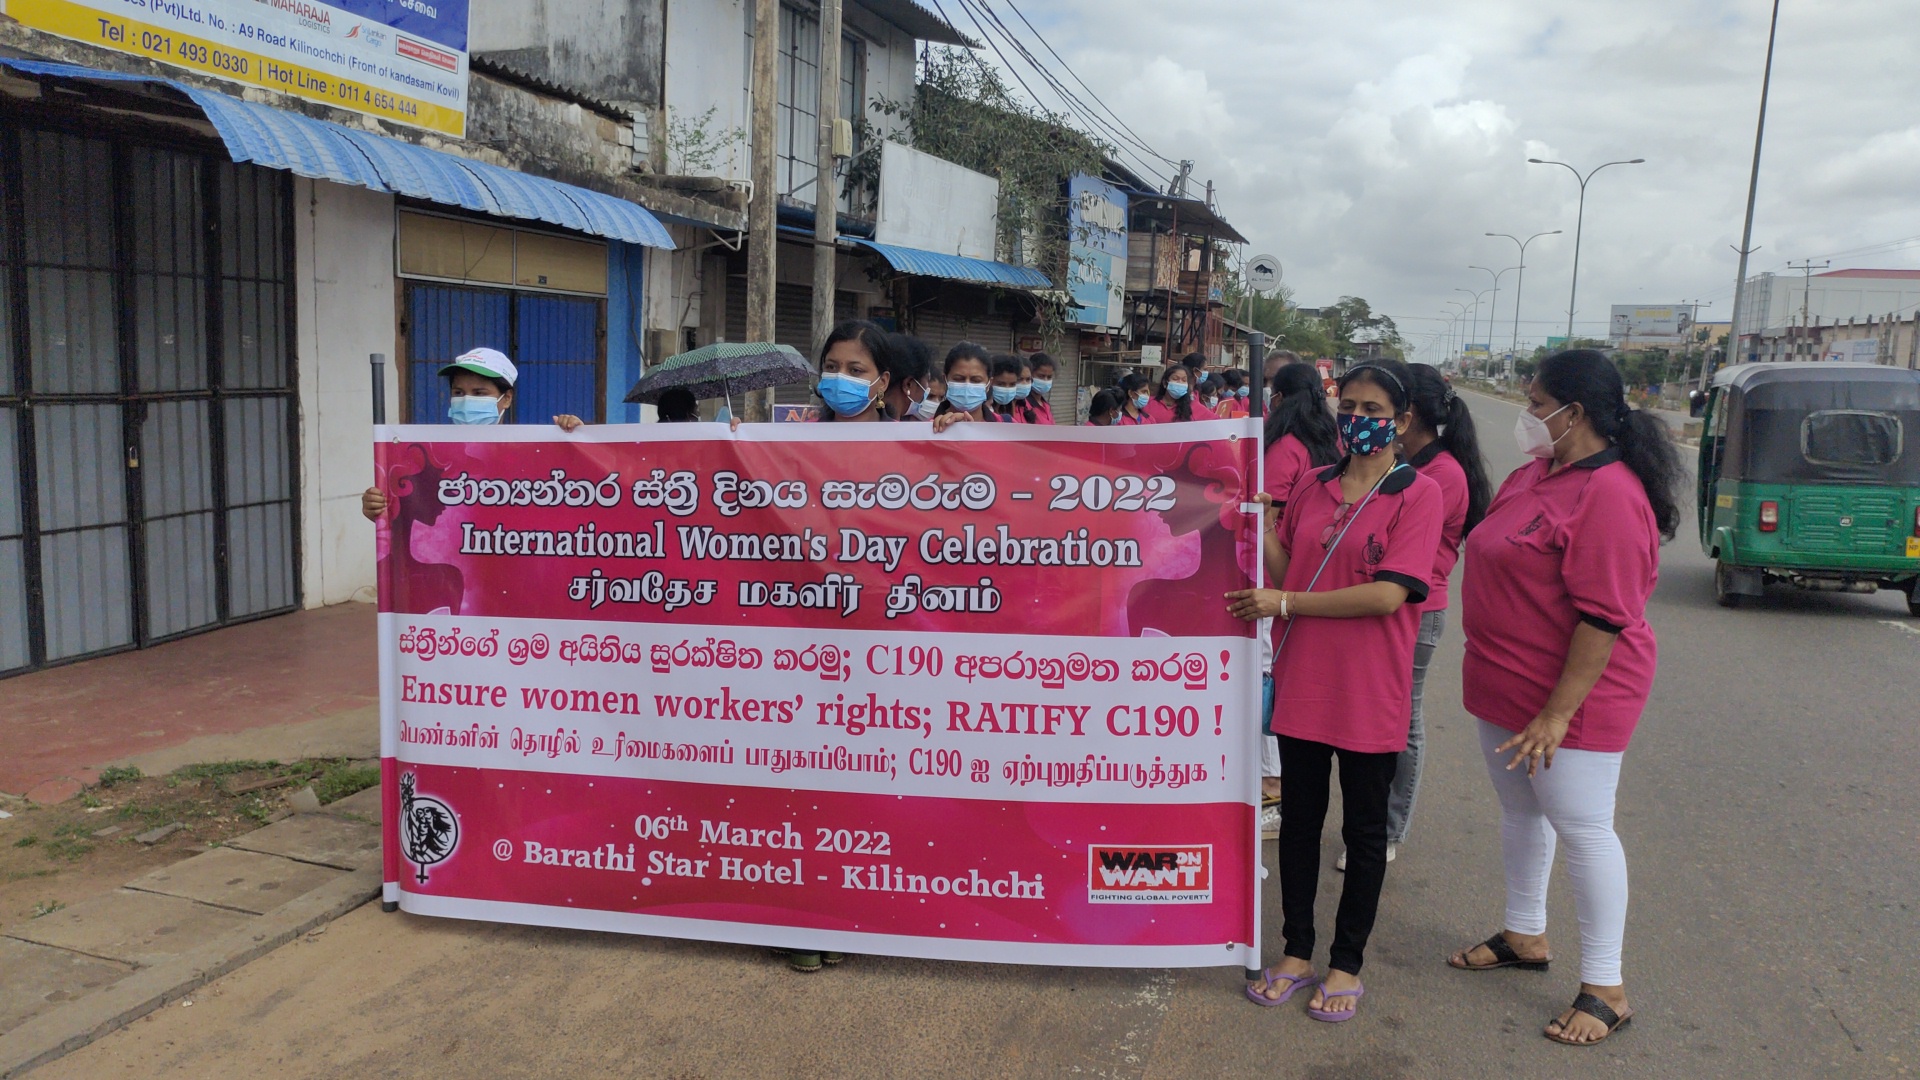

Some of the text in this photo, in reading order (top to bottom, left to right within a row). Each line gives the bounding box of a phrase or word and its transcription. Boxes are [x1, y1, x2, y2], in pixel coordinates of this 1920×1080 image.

[271, 0, 331, 25] MAHARAJA
[299, 17, 331, 34] LOGISTICS
[98, 18, 124, 43] Tel
[142, 31, 171, 54] 021
[179, 42, 208, 64] 493
[213, 51, 249, 75] 0330
[268, 63, 294, 85] Hot
[297, 70, 327, 94] Line
[339, 86, 359, 103] 011
[363, 92, 371, 105] 4
[374, 94, 394, 111] 654
[398, 101, 417, 117] 444
[209, 14, 228, 31] No.
[239, 23, 254, 38] A9
[257, 28, 286, 47] Road
[289, 38, 346, 66] Kilinochchi
[348, 55, 377, 75] (Front
[379, 64, 388, 78] of
[390, 70, 435, 93] kandasami
[437, 82, 460, 101] Kovil)
[714, 472, 807, 515] දිනය
[822, 474, 995, 509] සැමරුම
[1050, 476, 1176, 510] 2022
[461, 522, 1140, 571] International Women's Day Celebration
[570, 570, 1000, 617] சர்வதேச மகளிர் தினம்
[559, 634, 641, 665] අයිතිය
[650, 638, 762, 673] සුරක්ෂිත
[774, 644, 850, 682] කරමු;
[866, 645, 943, 676] C190
[954, 650, 1119, 689] අපරානුමත
[1132, 652, 1208, 690] කරමු
[402, 676, 507, 707] Ensure
[521, 688, 640, 714] women
[817, 693, 931, 738] rights;
[947, 701, 1091, 736] RATIFY
[1106, 705, 1199, 737] C190
[400, 720, 499, 749] பெண்களின்
[511, 726, 581, 759] தொழில்
[592, 732, 733, 764] உரிமைகளைப்
[746, 745, 896, 780] பாதுகாப்போம்;
[909, 748, 962, 776] C190
[970, 760, 989, 782] ஐ
[1003, 754, 1207, 788] ஏற்புறுதிப்படுத்துக
[635, 815, 890, 855] 06th March 2022
[493, 839, 512, 860] @
[524, 842, 635, 871] Barathi
[648, 851, 708, 877] Star
[720, 857, 804, 884] Hotel
[842, 865, 1044, 898] Kilinochchi
[1099, 865, 1202, 886] WANT
[1100, 850, 1202, 871] WAR ON
